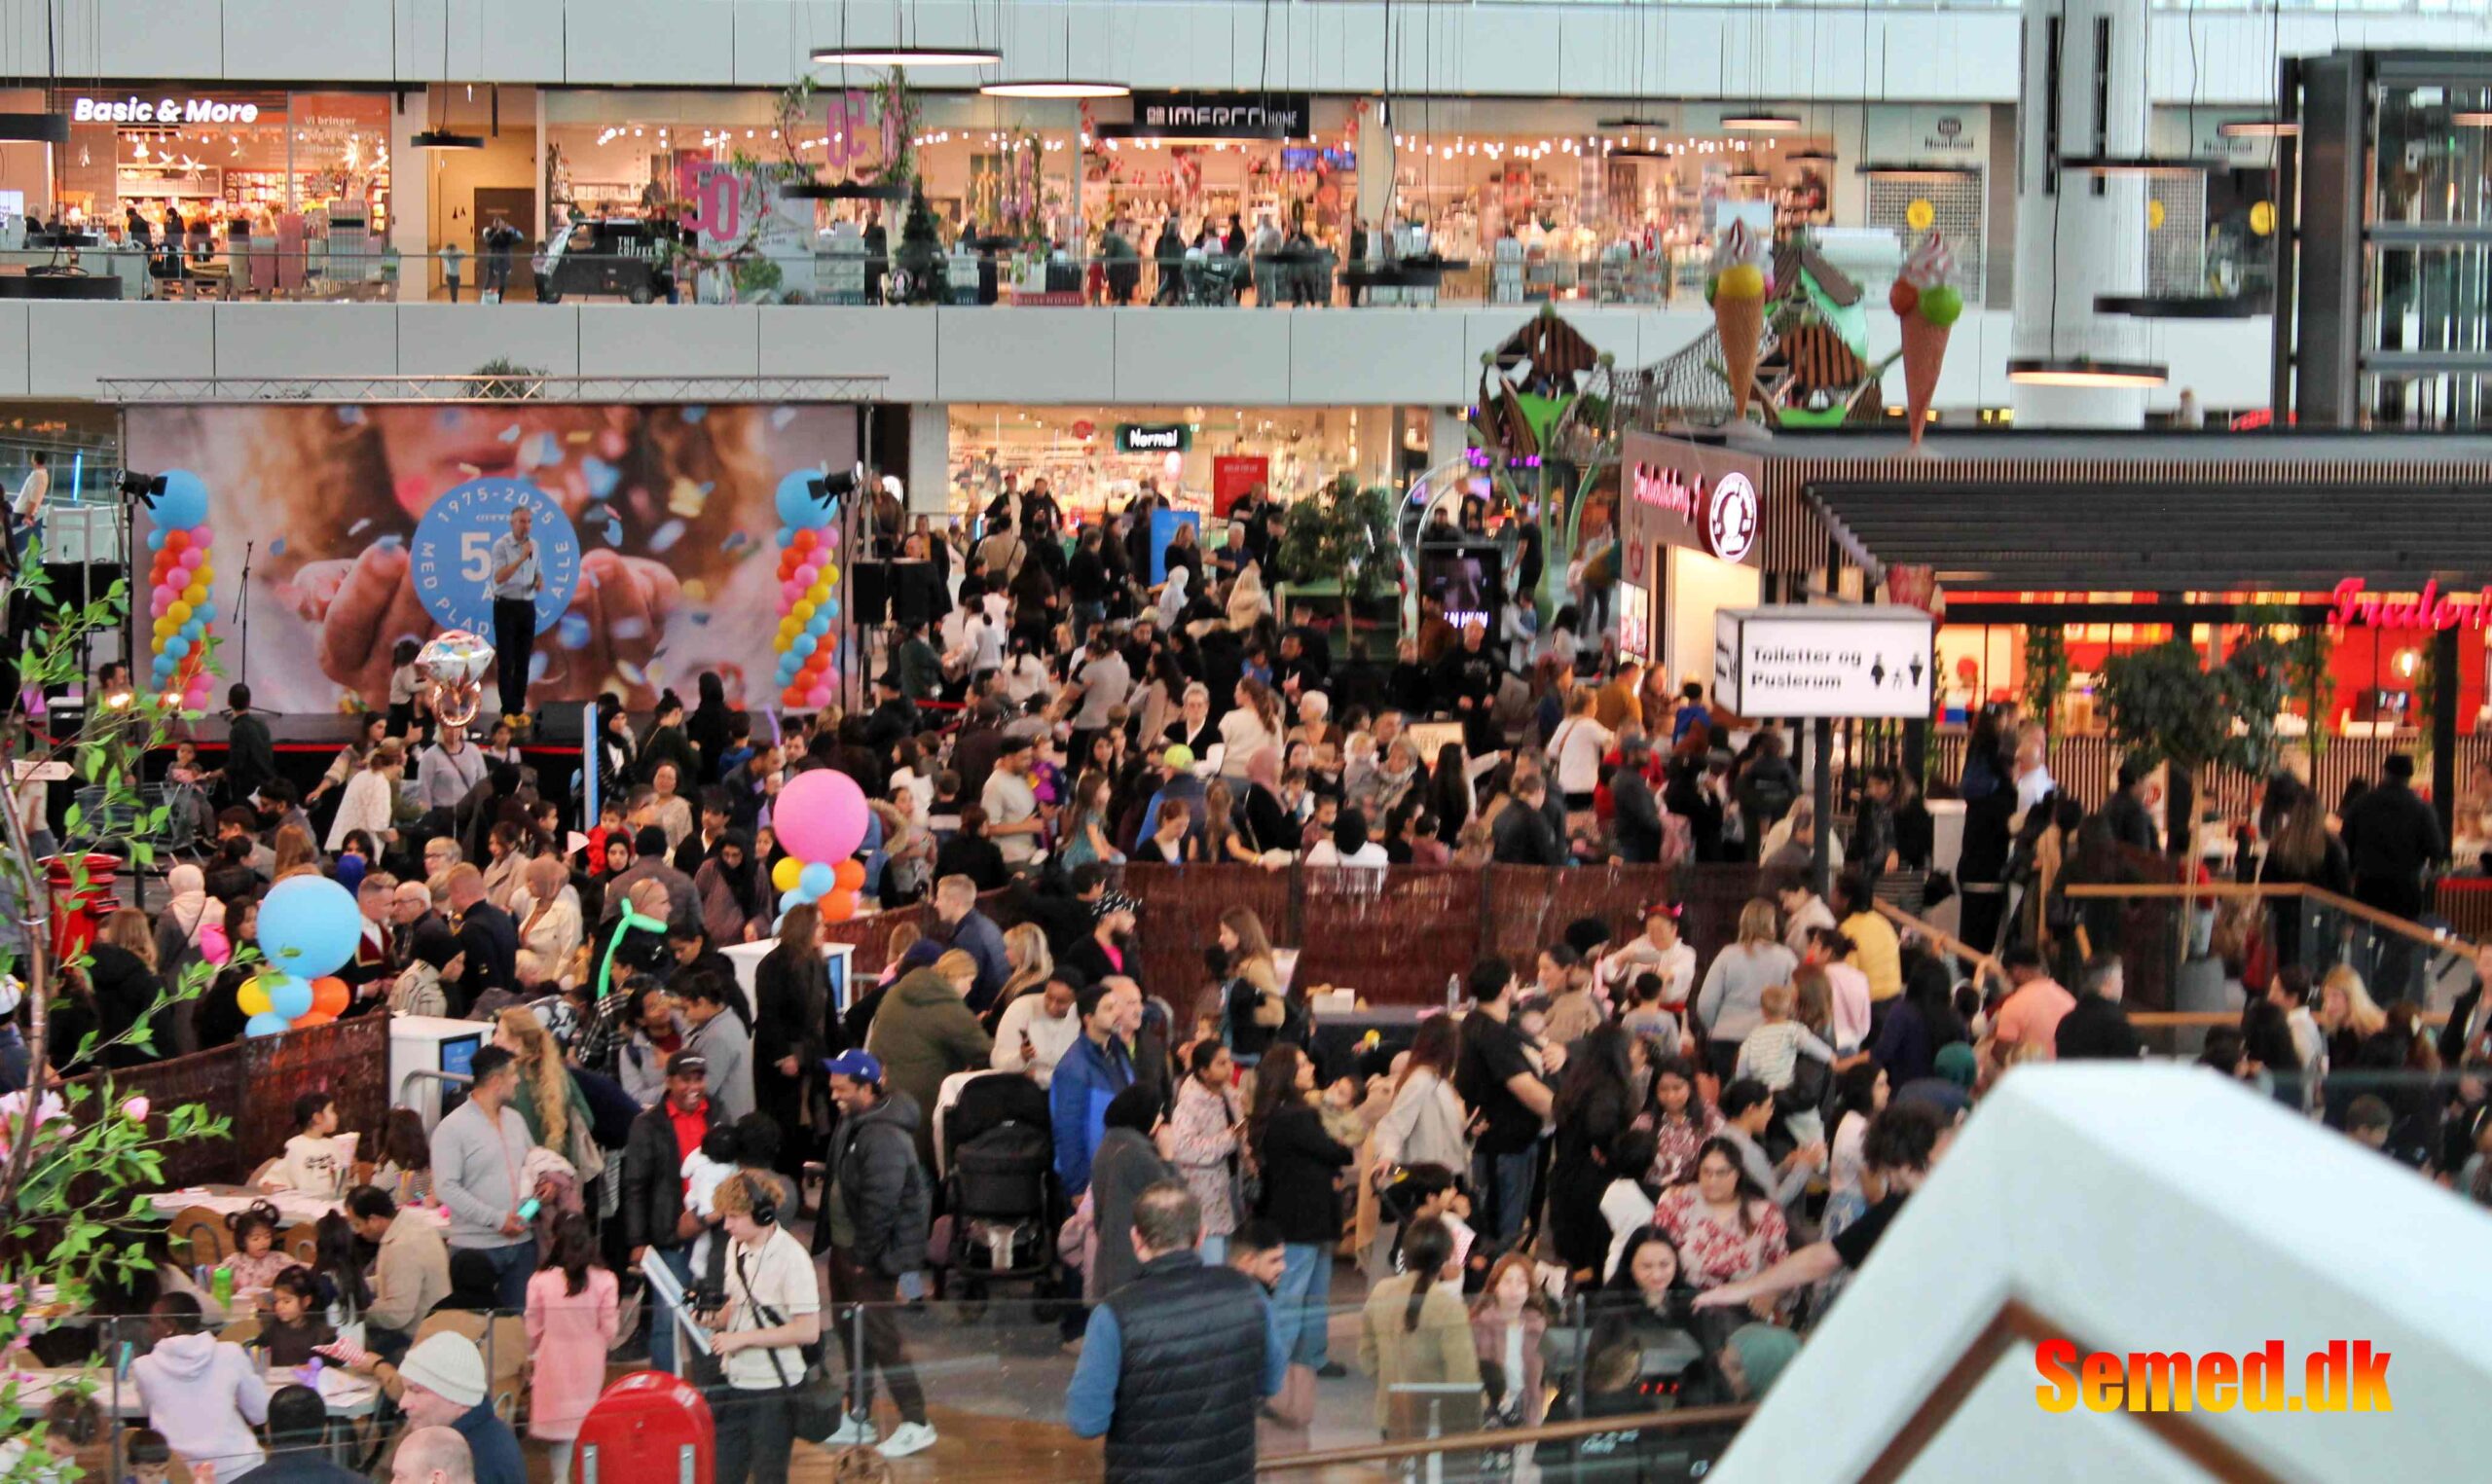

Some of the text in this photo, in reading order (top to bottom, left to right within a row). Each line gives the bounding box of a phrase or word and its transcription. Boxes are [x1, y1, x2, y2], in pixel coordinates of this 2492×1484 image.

[75, 96, 258, 123] Basic & More
[317, 116, 357, 127] bringer
[678, 163, 739, 241] 50
[617, 235, 636, 246] THE
[1130, 428, 1178, 448] Normal
[439, 488, 555, 525] 1975-2025
[461, 532, 492, 581] 5
[551, 541, 570, 598] ALLE
[421, 542, 490, 634] MED PLAD
[1754, 646, 1830, 664] Toiletter
[1839, 650, 1862, 669] og
[1752, 671, 1842, 688] Puslerum
